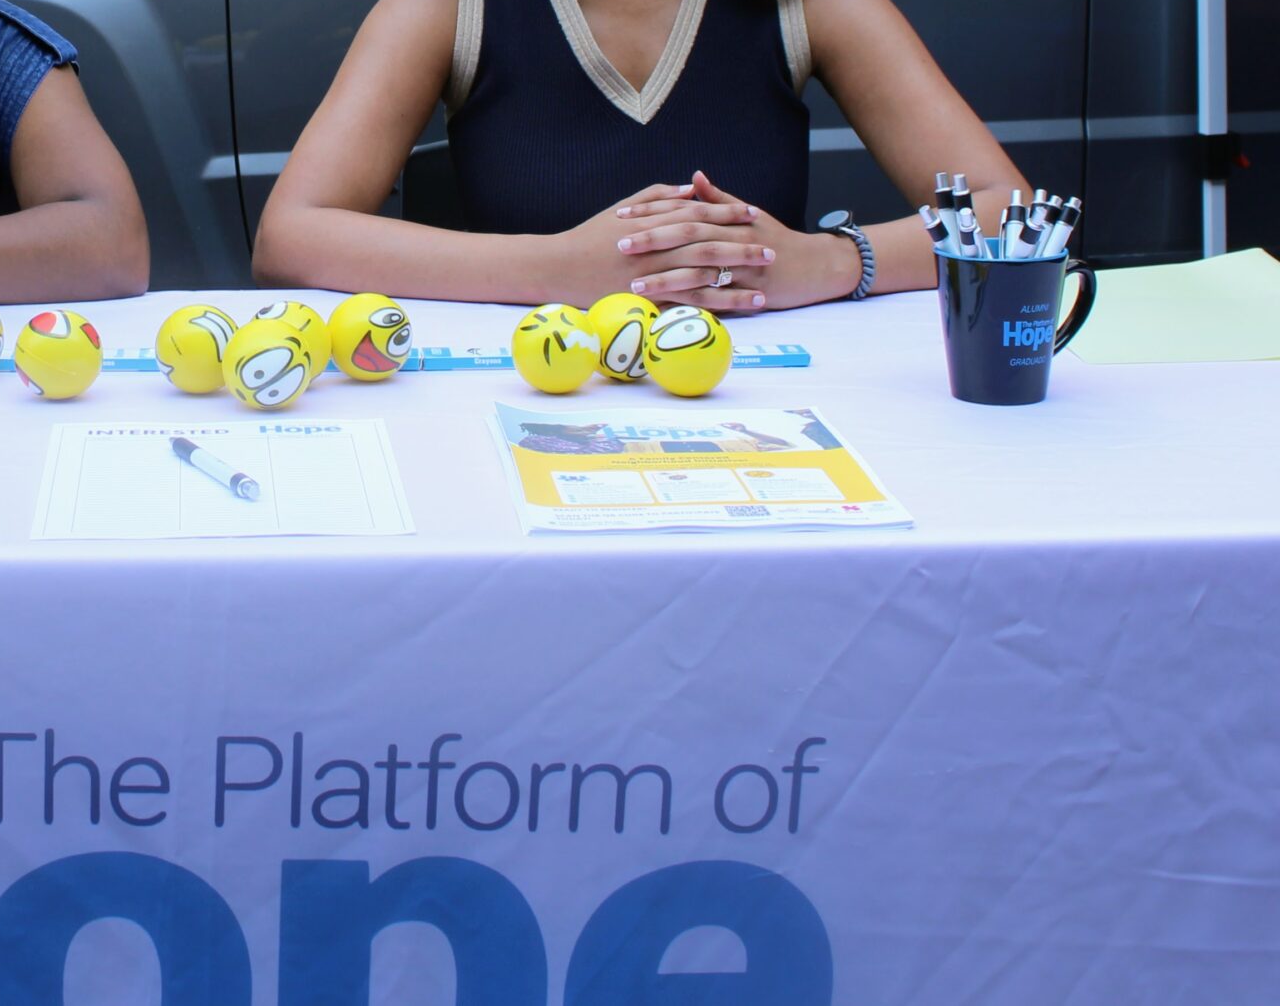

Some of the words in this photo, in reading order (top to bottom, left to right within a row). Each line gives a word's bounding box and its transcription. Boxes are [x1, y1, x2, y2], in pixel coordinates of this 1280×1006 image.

[1003, 321, 1054, 351] Hope
[259, 425, 342, 435] Hope
[602, 426, 723, 440] Hope
[214, 731, 671, 835] Platform
[714, 736, 828, 835] of
